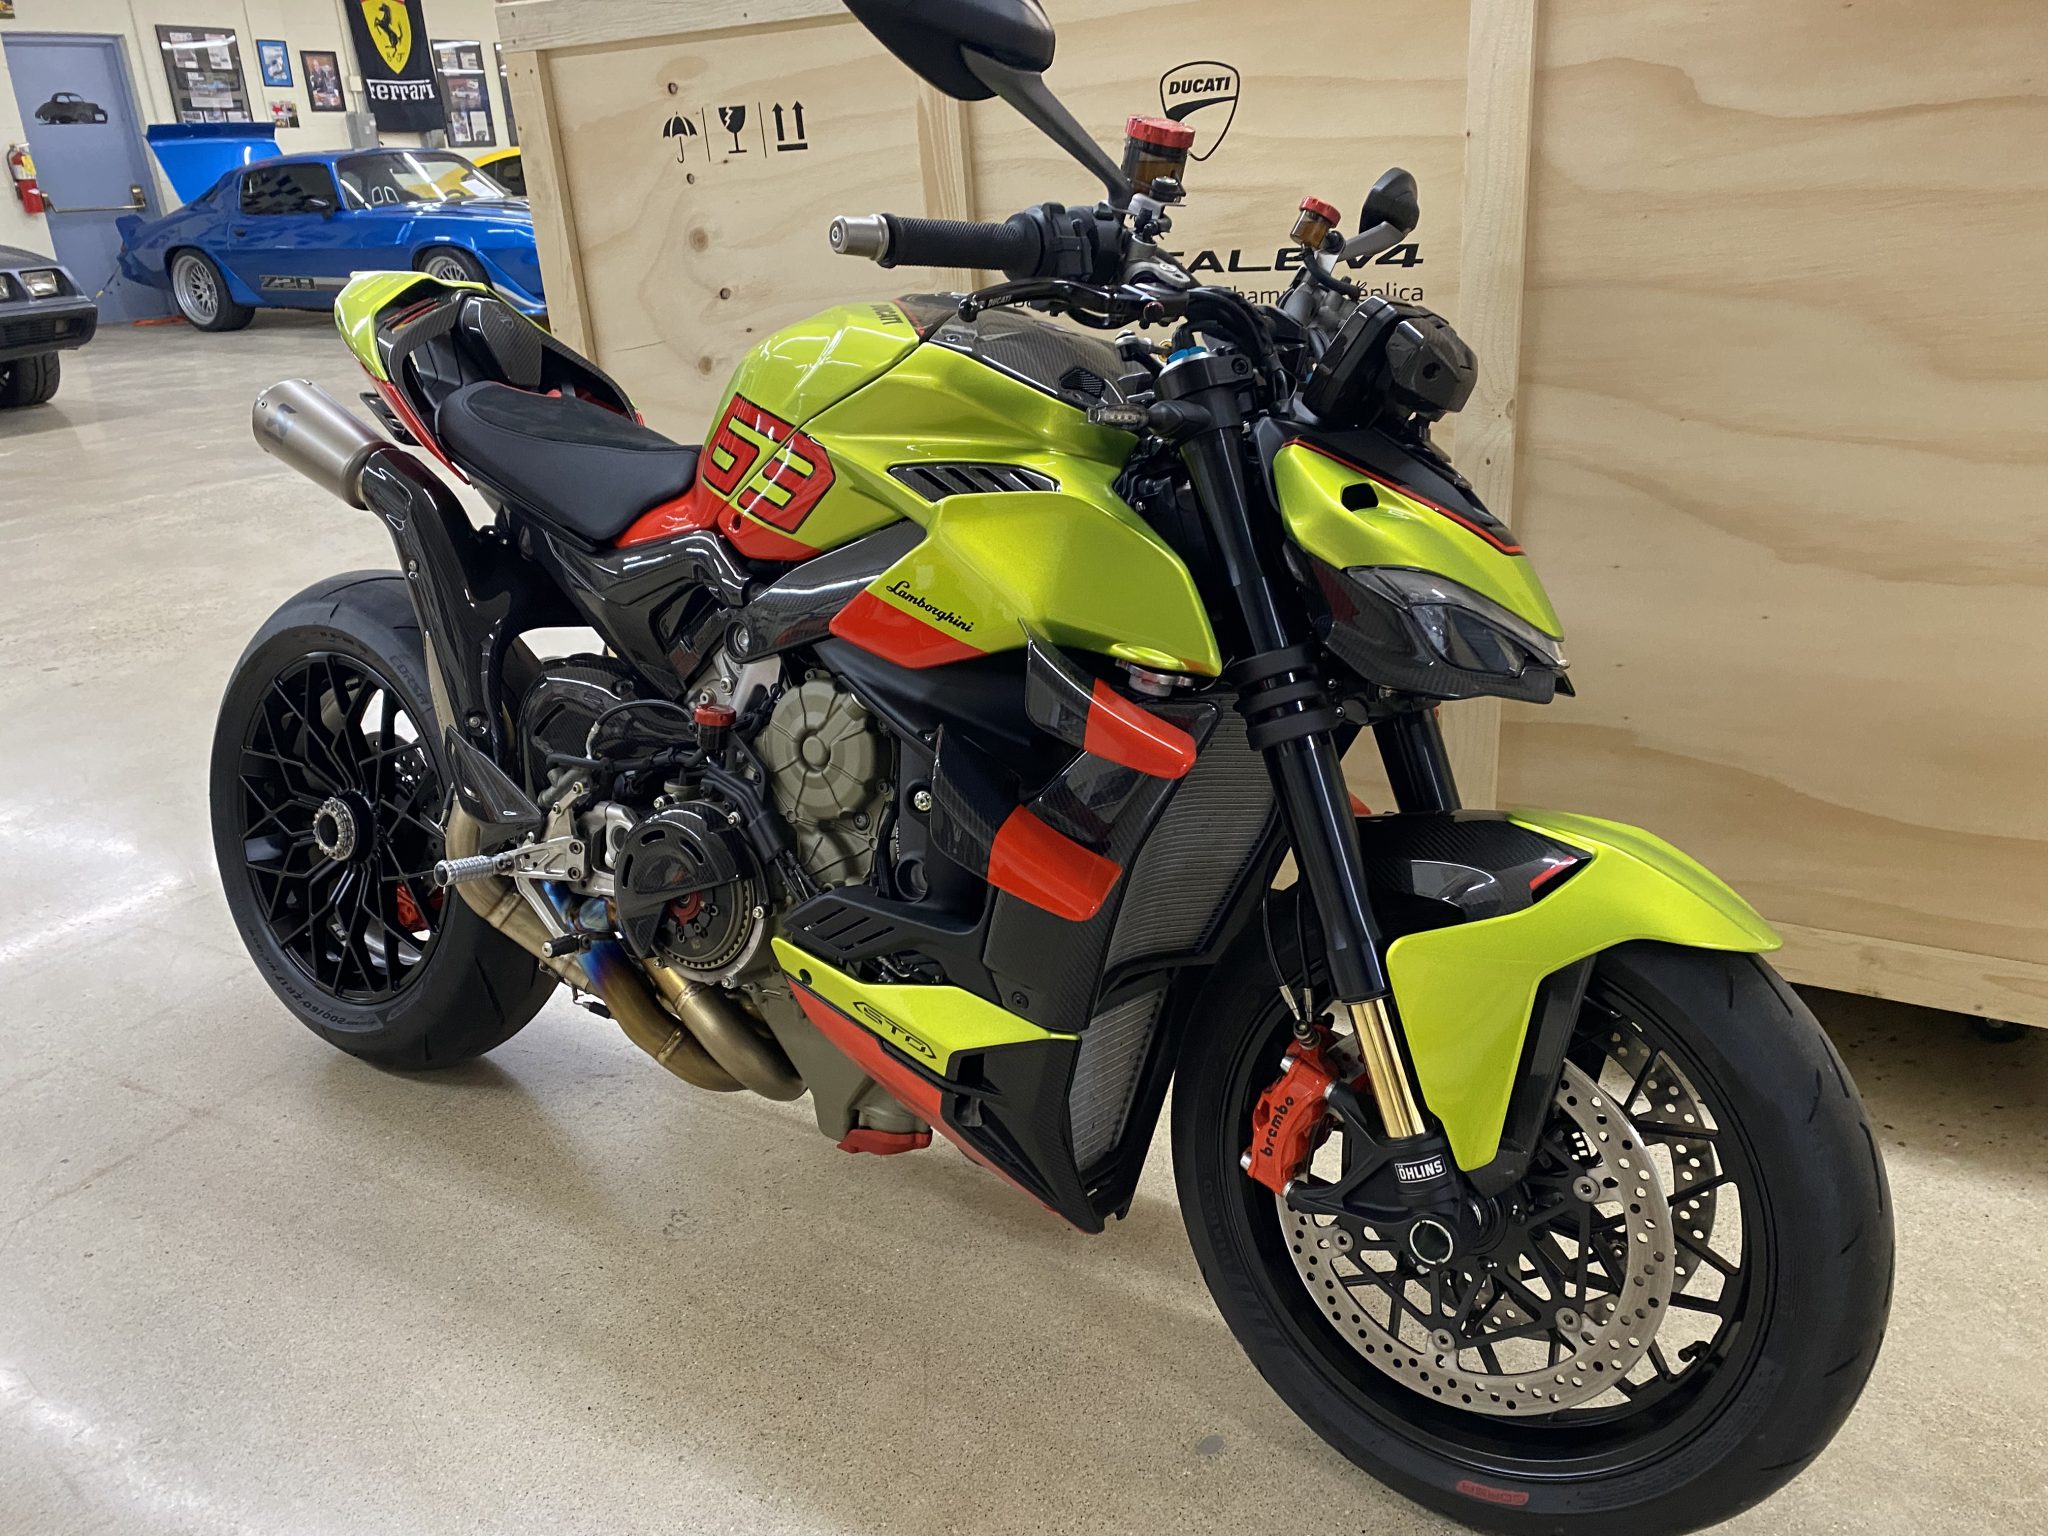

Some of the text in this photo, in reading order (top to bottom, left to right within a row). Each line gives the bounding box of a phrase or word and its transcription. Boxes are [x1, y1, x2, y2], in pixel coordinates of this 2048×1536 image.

[366, 79, 435, 101] Ferrari
[1168, 76, 1231, 95] DUCATI
[702, 391, 836, 534] 63
[885, 580, 974, 632] Lamborghini
[862, 1005, 927, 1054] STO
[1259, 1096, 1295, 1157] brembo
[1397, 1160, 1443, 1180] ÖHLINS
